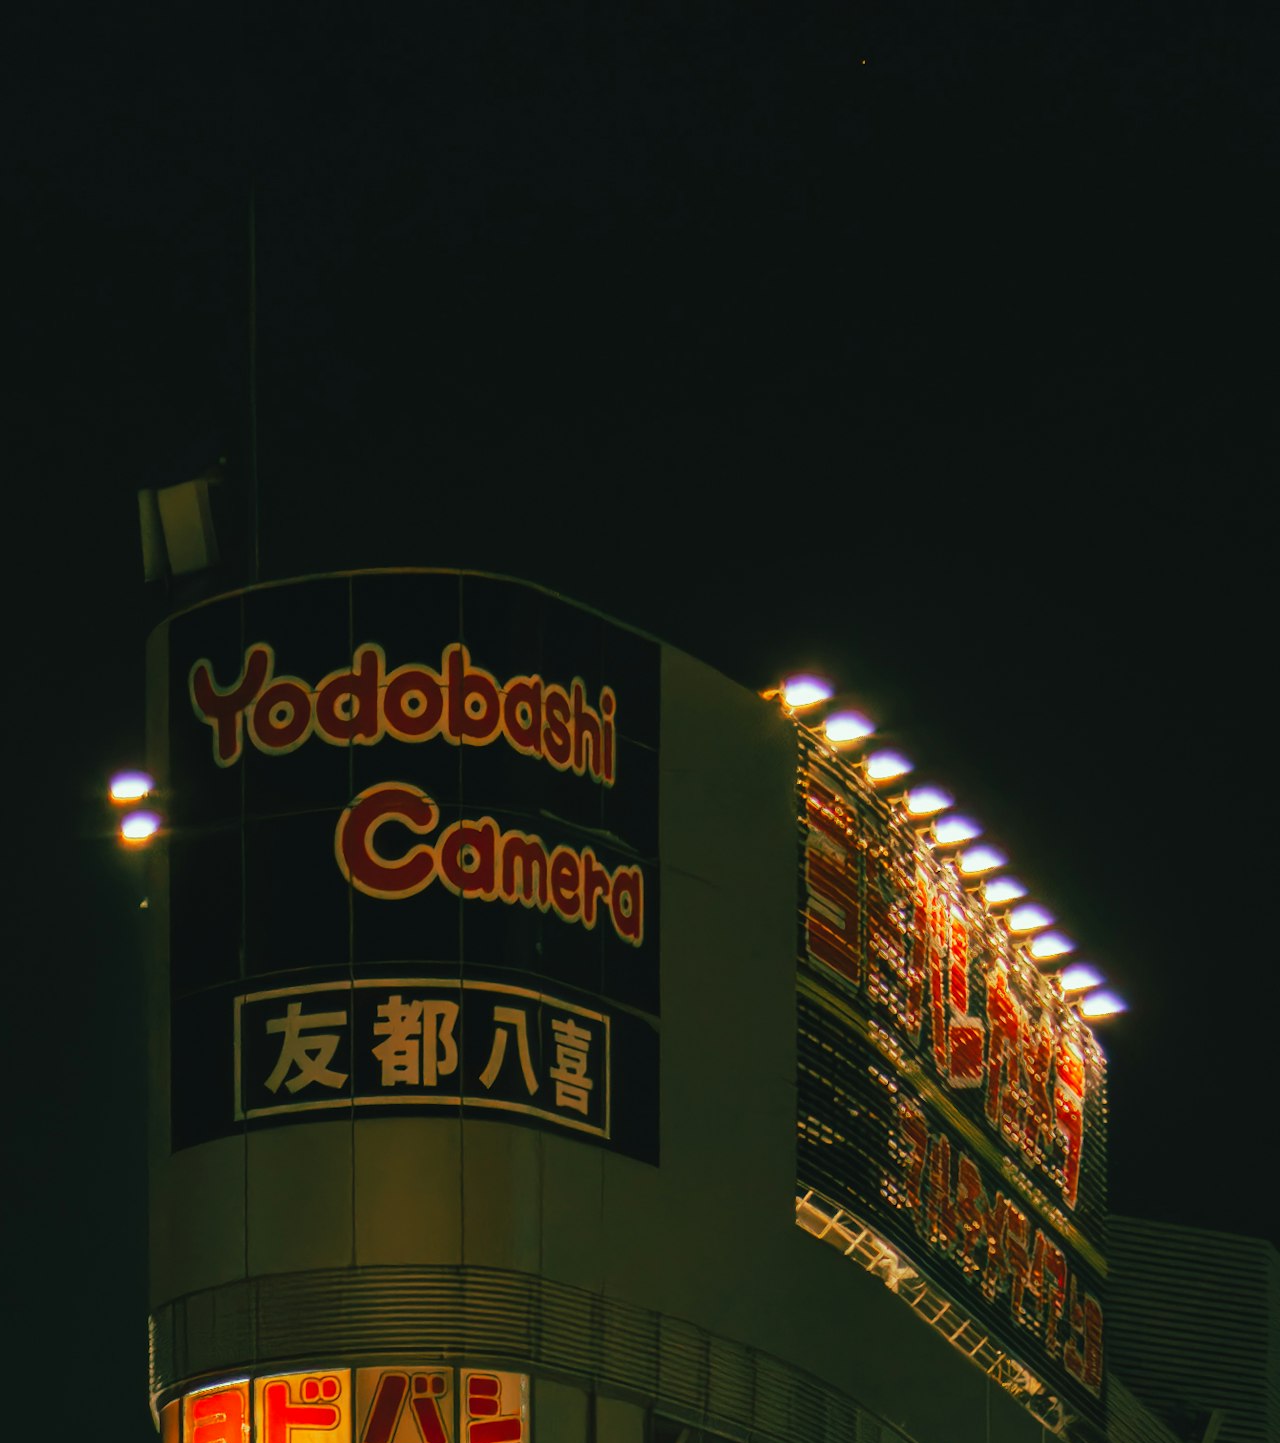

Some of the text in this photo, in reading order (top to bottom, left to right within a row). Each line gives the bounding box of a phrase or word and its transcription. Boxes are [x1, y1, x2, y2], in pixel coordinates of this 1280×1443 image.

[189, 642, 616, 787] Yodobashi
[335, 781, 643, 947] Camera
[264, 995, 594, 1116] 友都八喜
